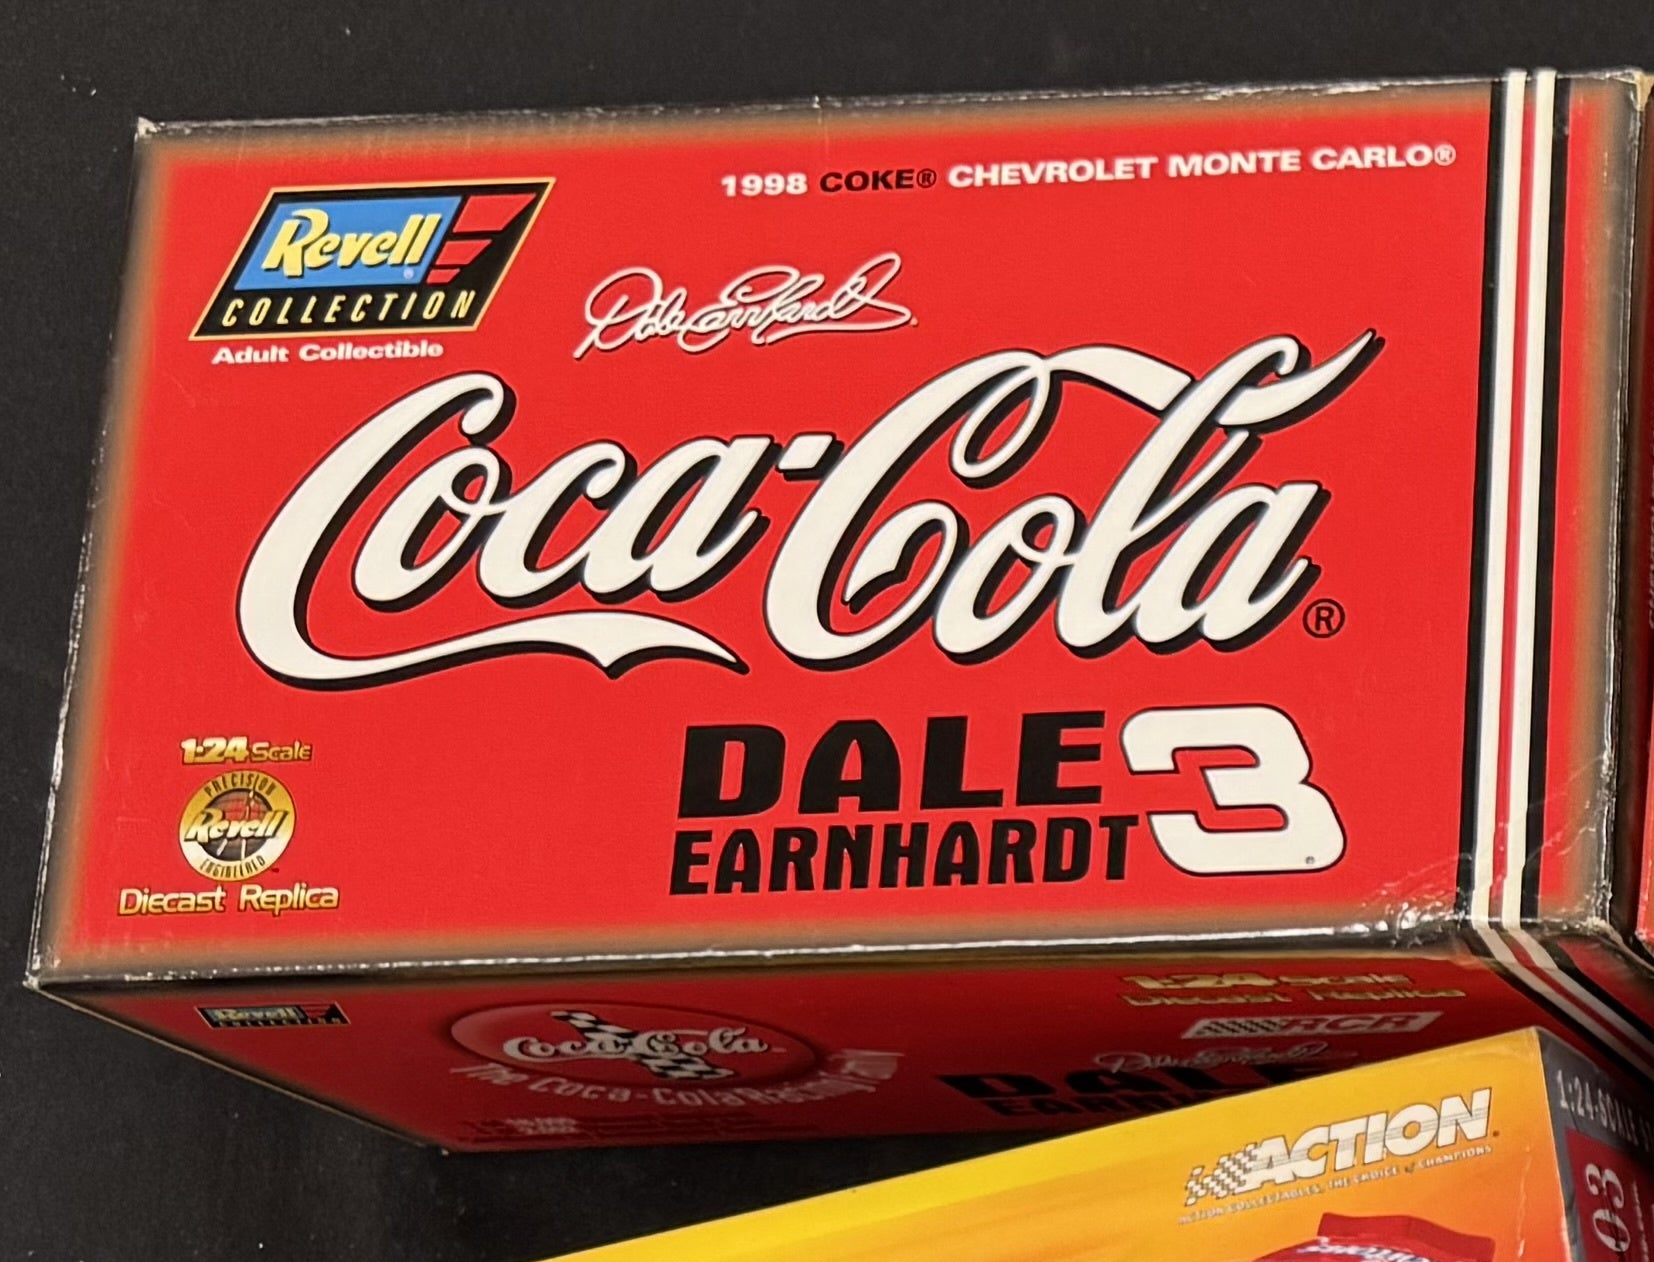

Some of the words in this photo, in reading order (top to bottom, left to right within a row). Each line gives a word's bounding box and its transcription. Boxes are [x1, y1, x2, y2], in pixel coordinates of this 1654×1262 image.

[720, 173, 807, 197] 1998
[948, 157, 1158, 188] CHEVROLET
[1168, 150, 1301, 179] MONTE
[261, 208, 441, 277] Revell
[221, 289, 476, 328] COLLECTION
[211, 345, 289, 365] Adult
[299, 341, 444, 362] Collectible
[236, 328, 1386, 689] Coca-Cola
[181, 737, 250, 764] 1:24
[250, 741, 313, 763] Scale
[685, 711, 1105, 818] DALE
[204, 773, 276, 797] PRECISION
[1120, 705, 1346, 876] 3
[184, 809, 288, 843] Revell
[672, 815, 1139, 894] EARNHARDT
[118, 884, 226, 916] Diecast
[239, 883, 340, 916] Replica
[1233, 1087, 1492, 1196] ACTION
